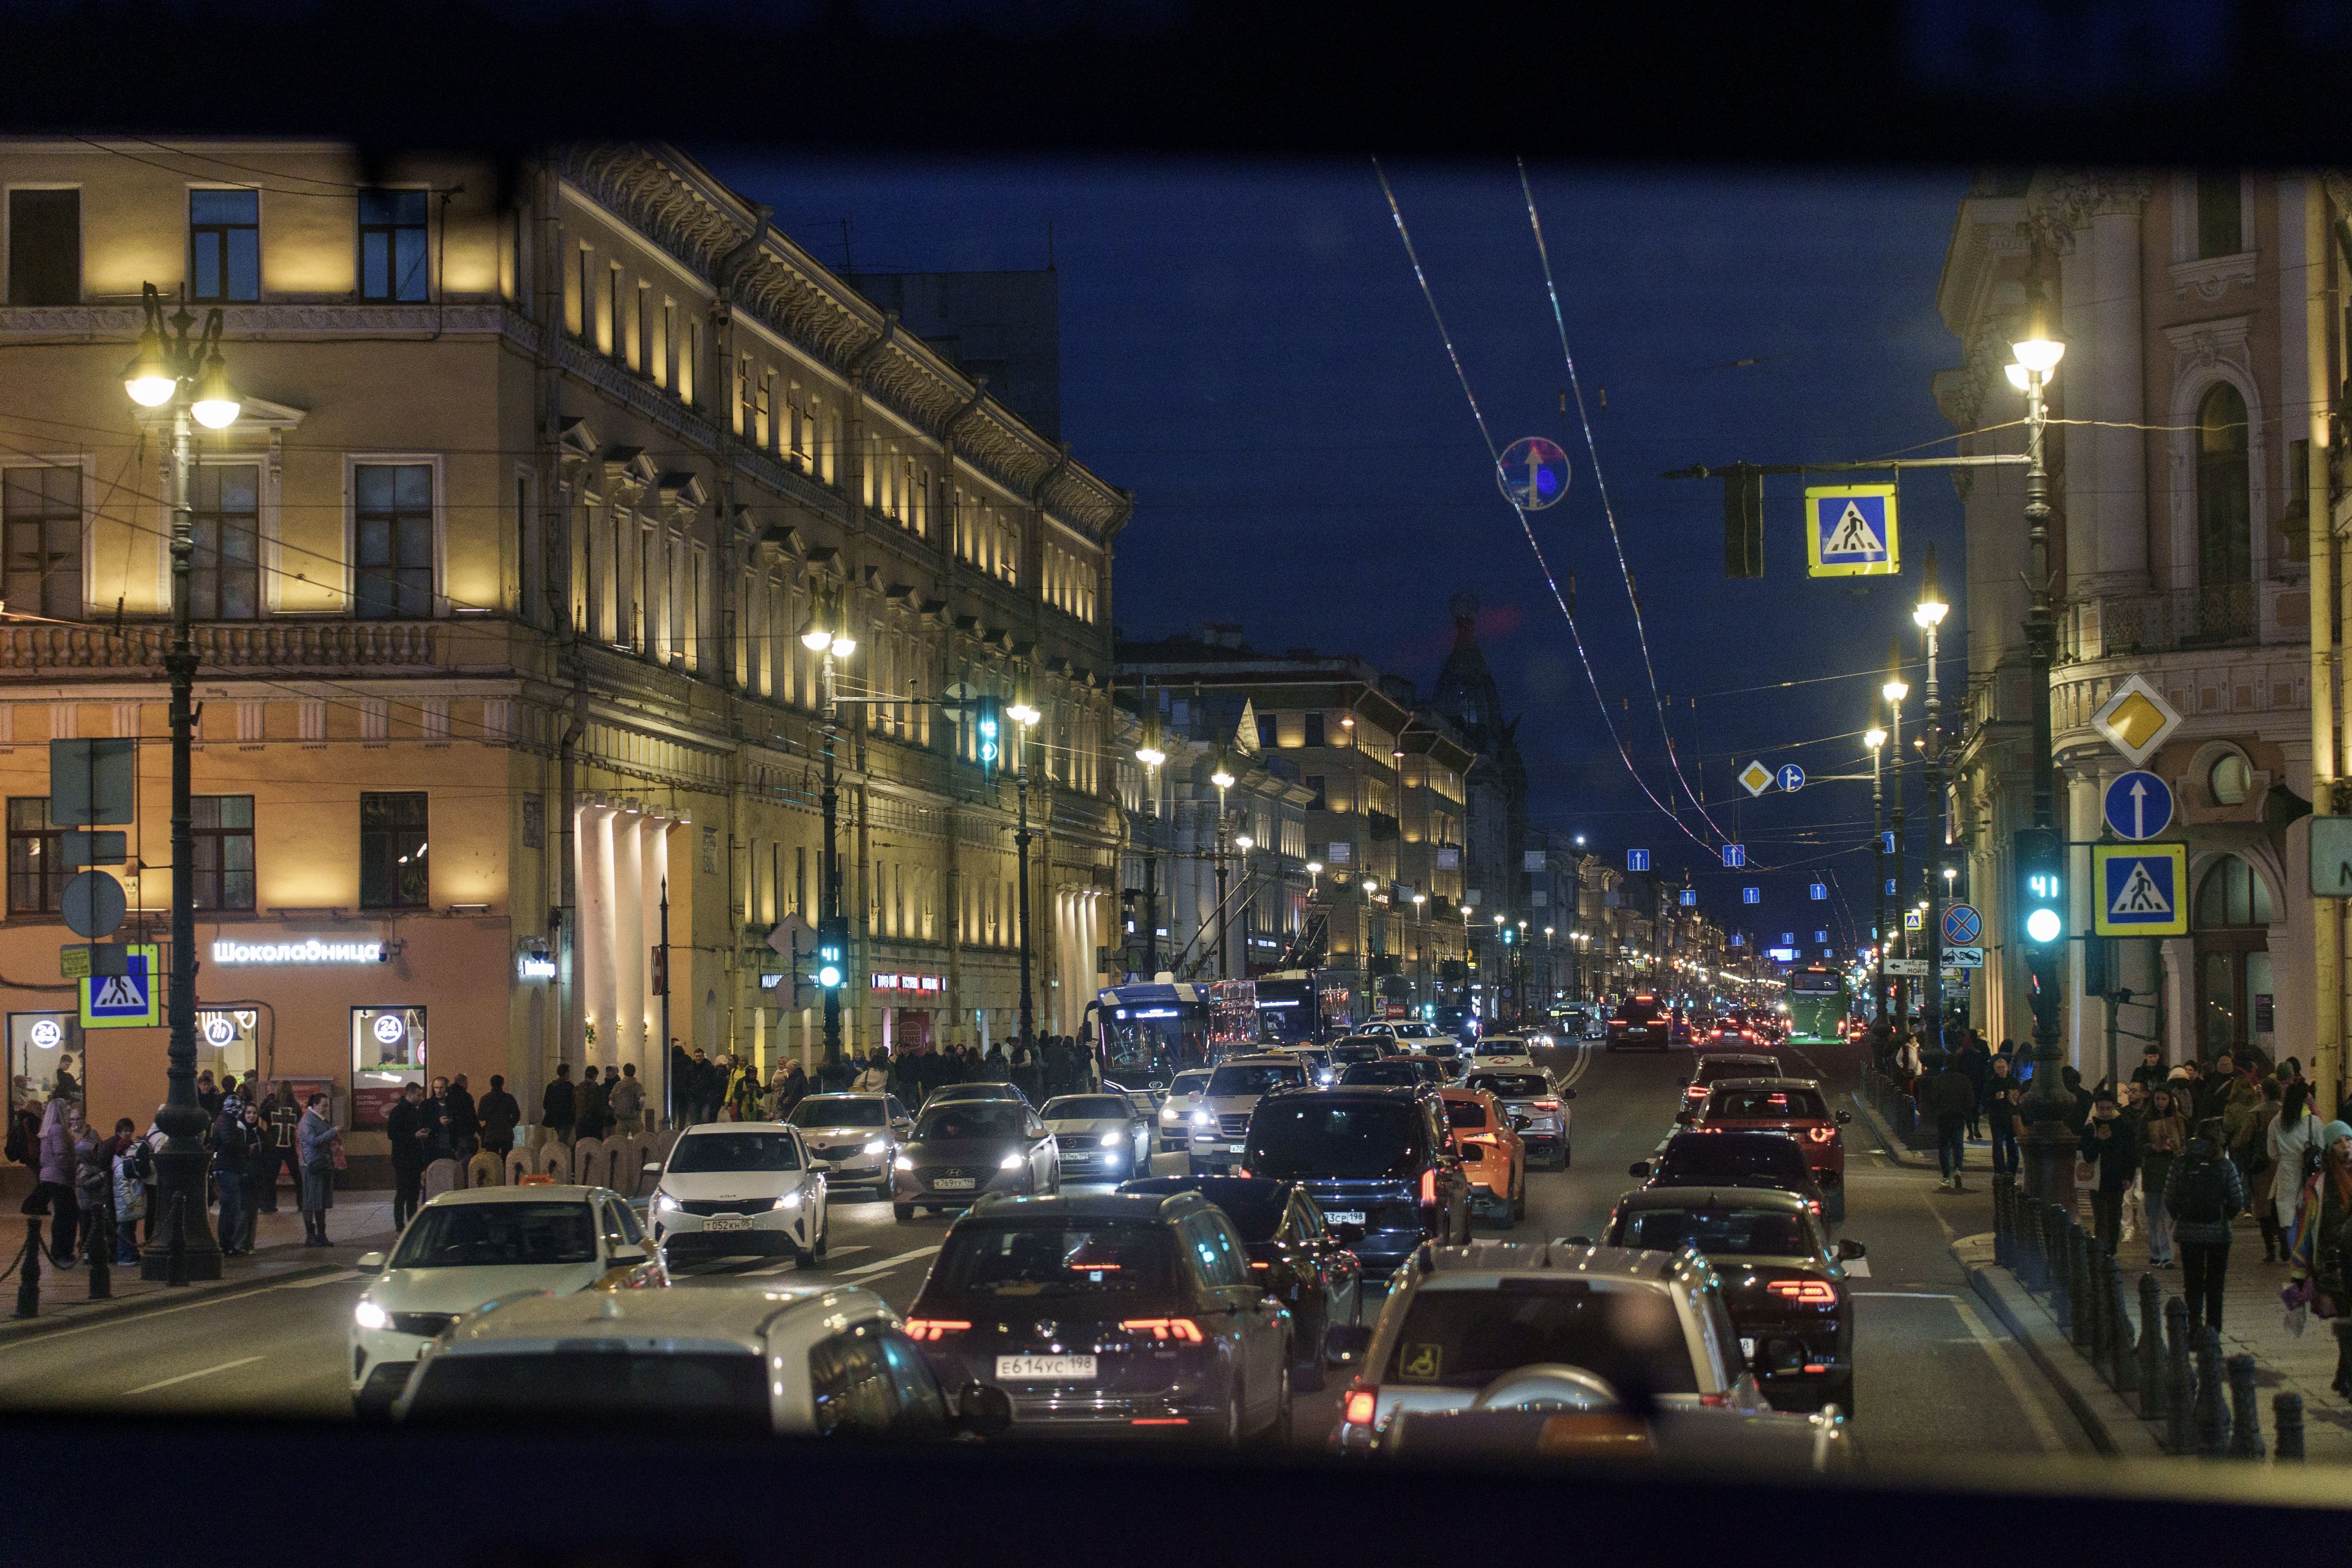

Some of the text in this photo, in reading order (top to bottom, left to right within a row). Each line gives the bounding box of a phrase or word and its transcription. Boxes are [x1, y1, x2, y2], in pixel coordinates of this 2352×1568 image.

[2031, 876, 2057, 898] 41
[214, 941, 380, 962] Шоколадница
[822, 948, 839, 961] 41
[38, 1025, 55, 1035] 24
[381, 1020, 397, 1030] 24
[706, 1221, 740, 1230] Т052КН
[1001, 1356, 1091, 1374] Е614УС 198
